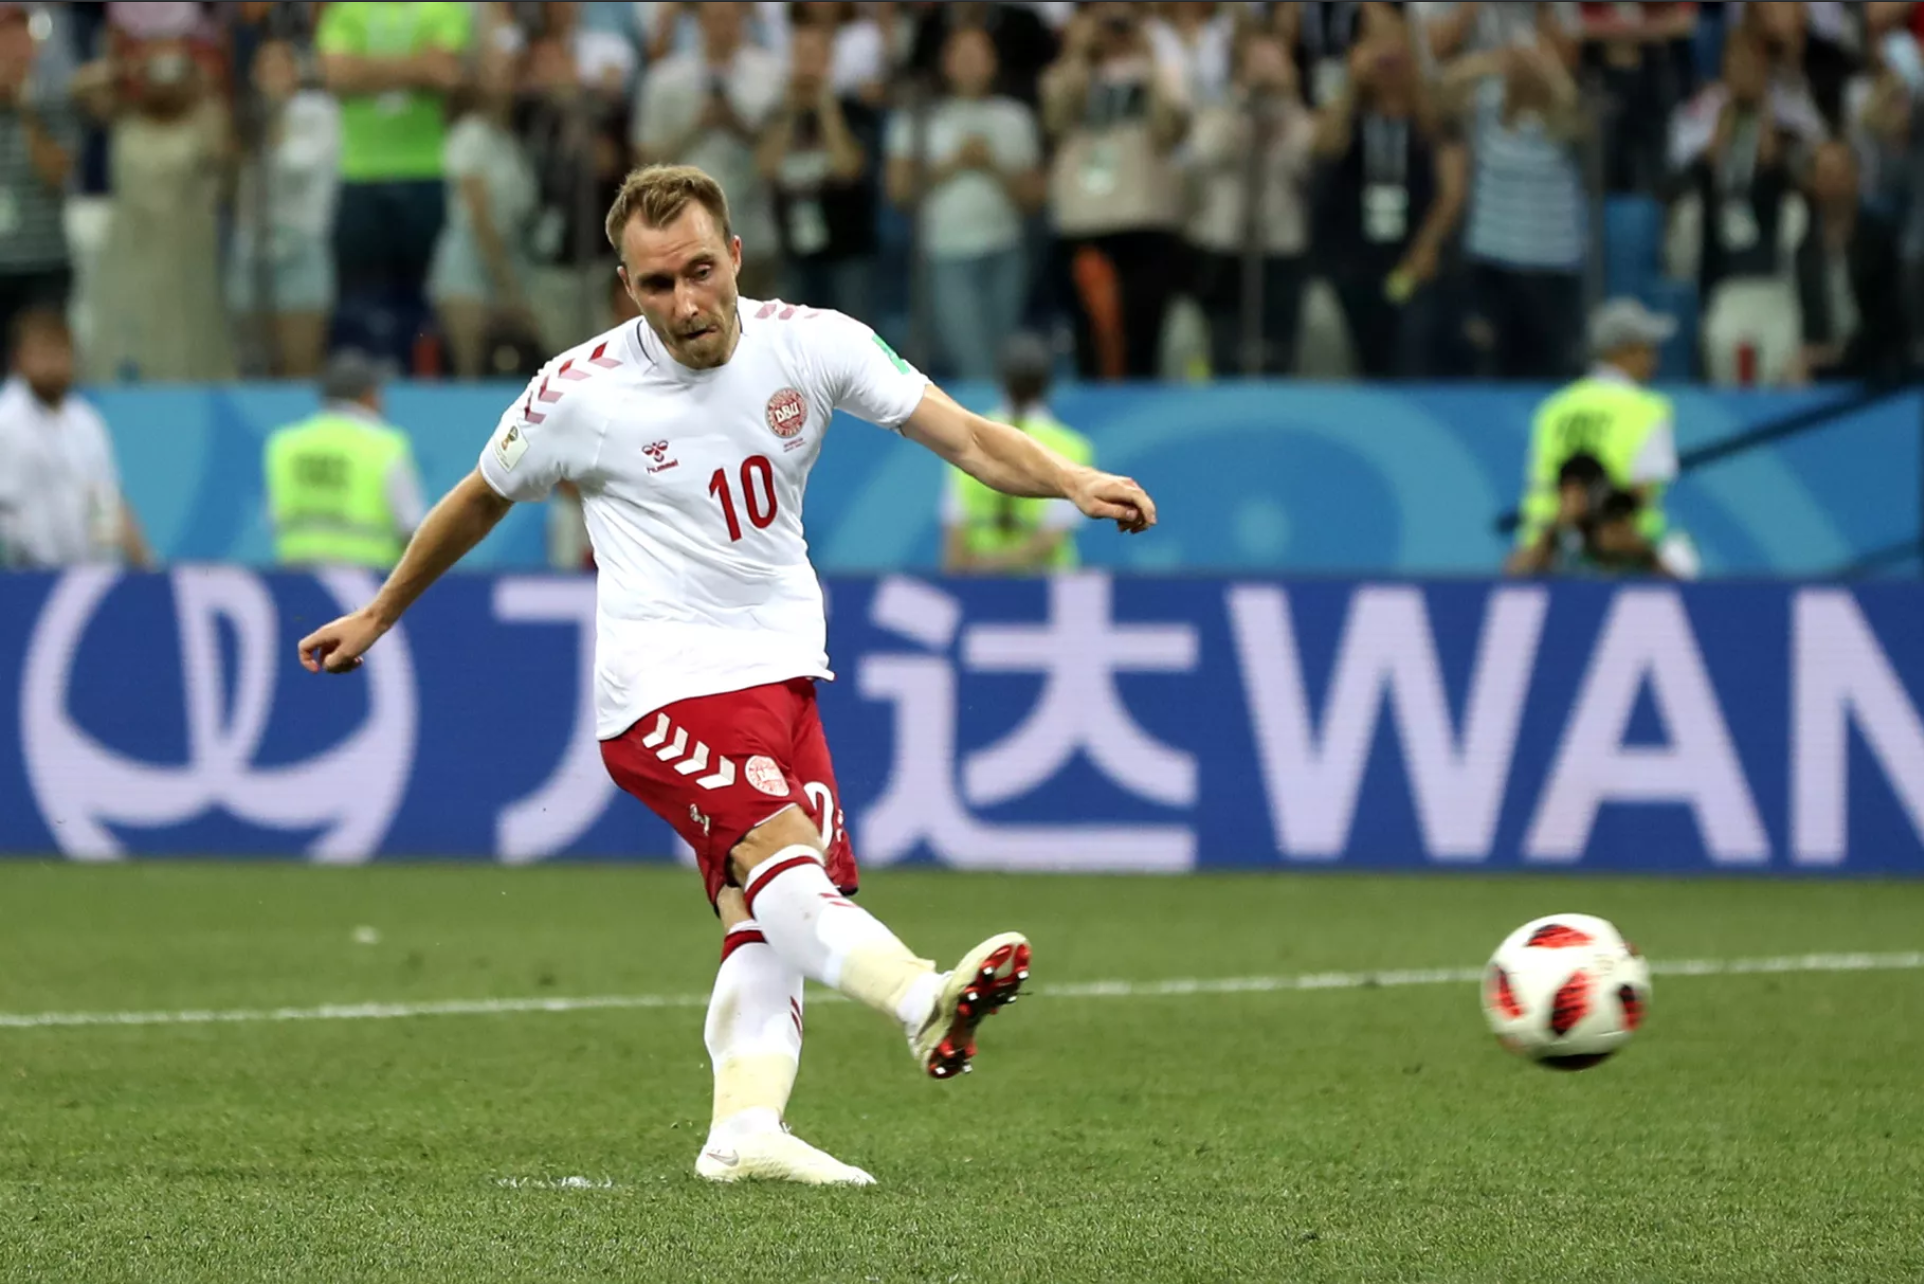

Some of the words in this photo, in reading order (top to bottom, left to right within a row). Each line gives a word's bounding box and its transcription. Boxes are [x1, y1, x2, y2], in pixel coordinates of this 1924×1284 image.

[775, 402, 800, 423] DBU
[709, 454, 777, 542] 10
[1226, 584, 1924, 867] WAN
